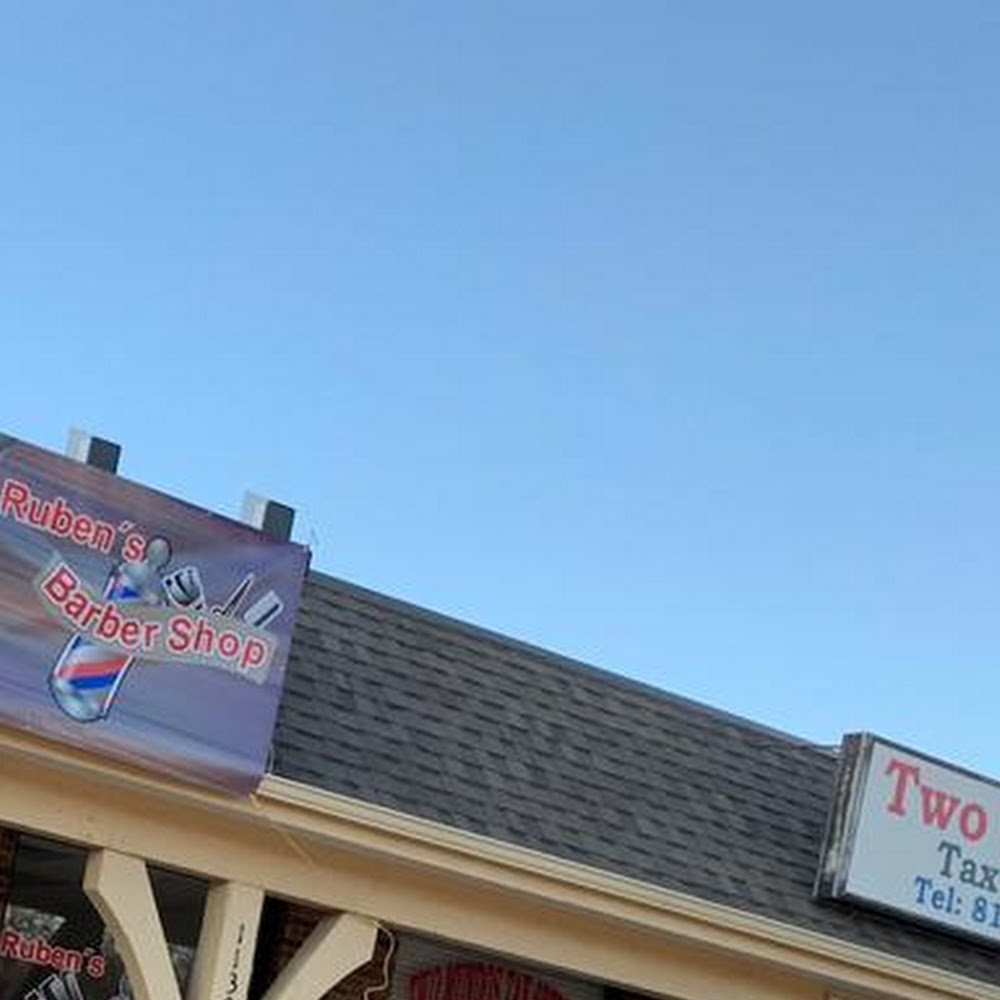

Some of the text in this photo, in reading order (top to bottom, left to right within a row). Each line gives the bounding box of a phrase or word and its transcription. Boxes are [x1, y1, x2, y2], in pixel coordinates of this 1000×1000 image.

[41, 560, 269, 674] Barber Shop
[937, 840, 1000, 894] Tax
[914, 875, 962, 915] Tel:
